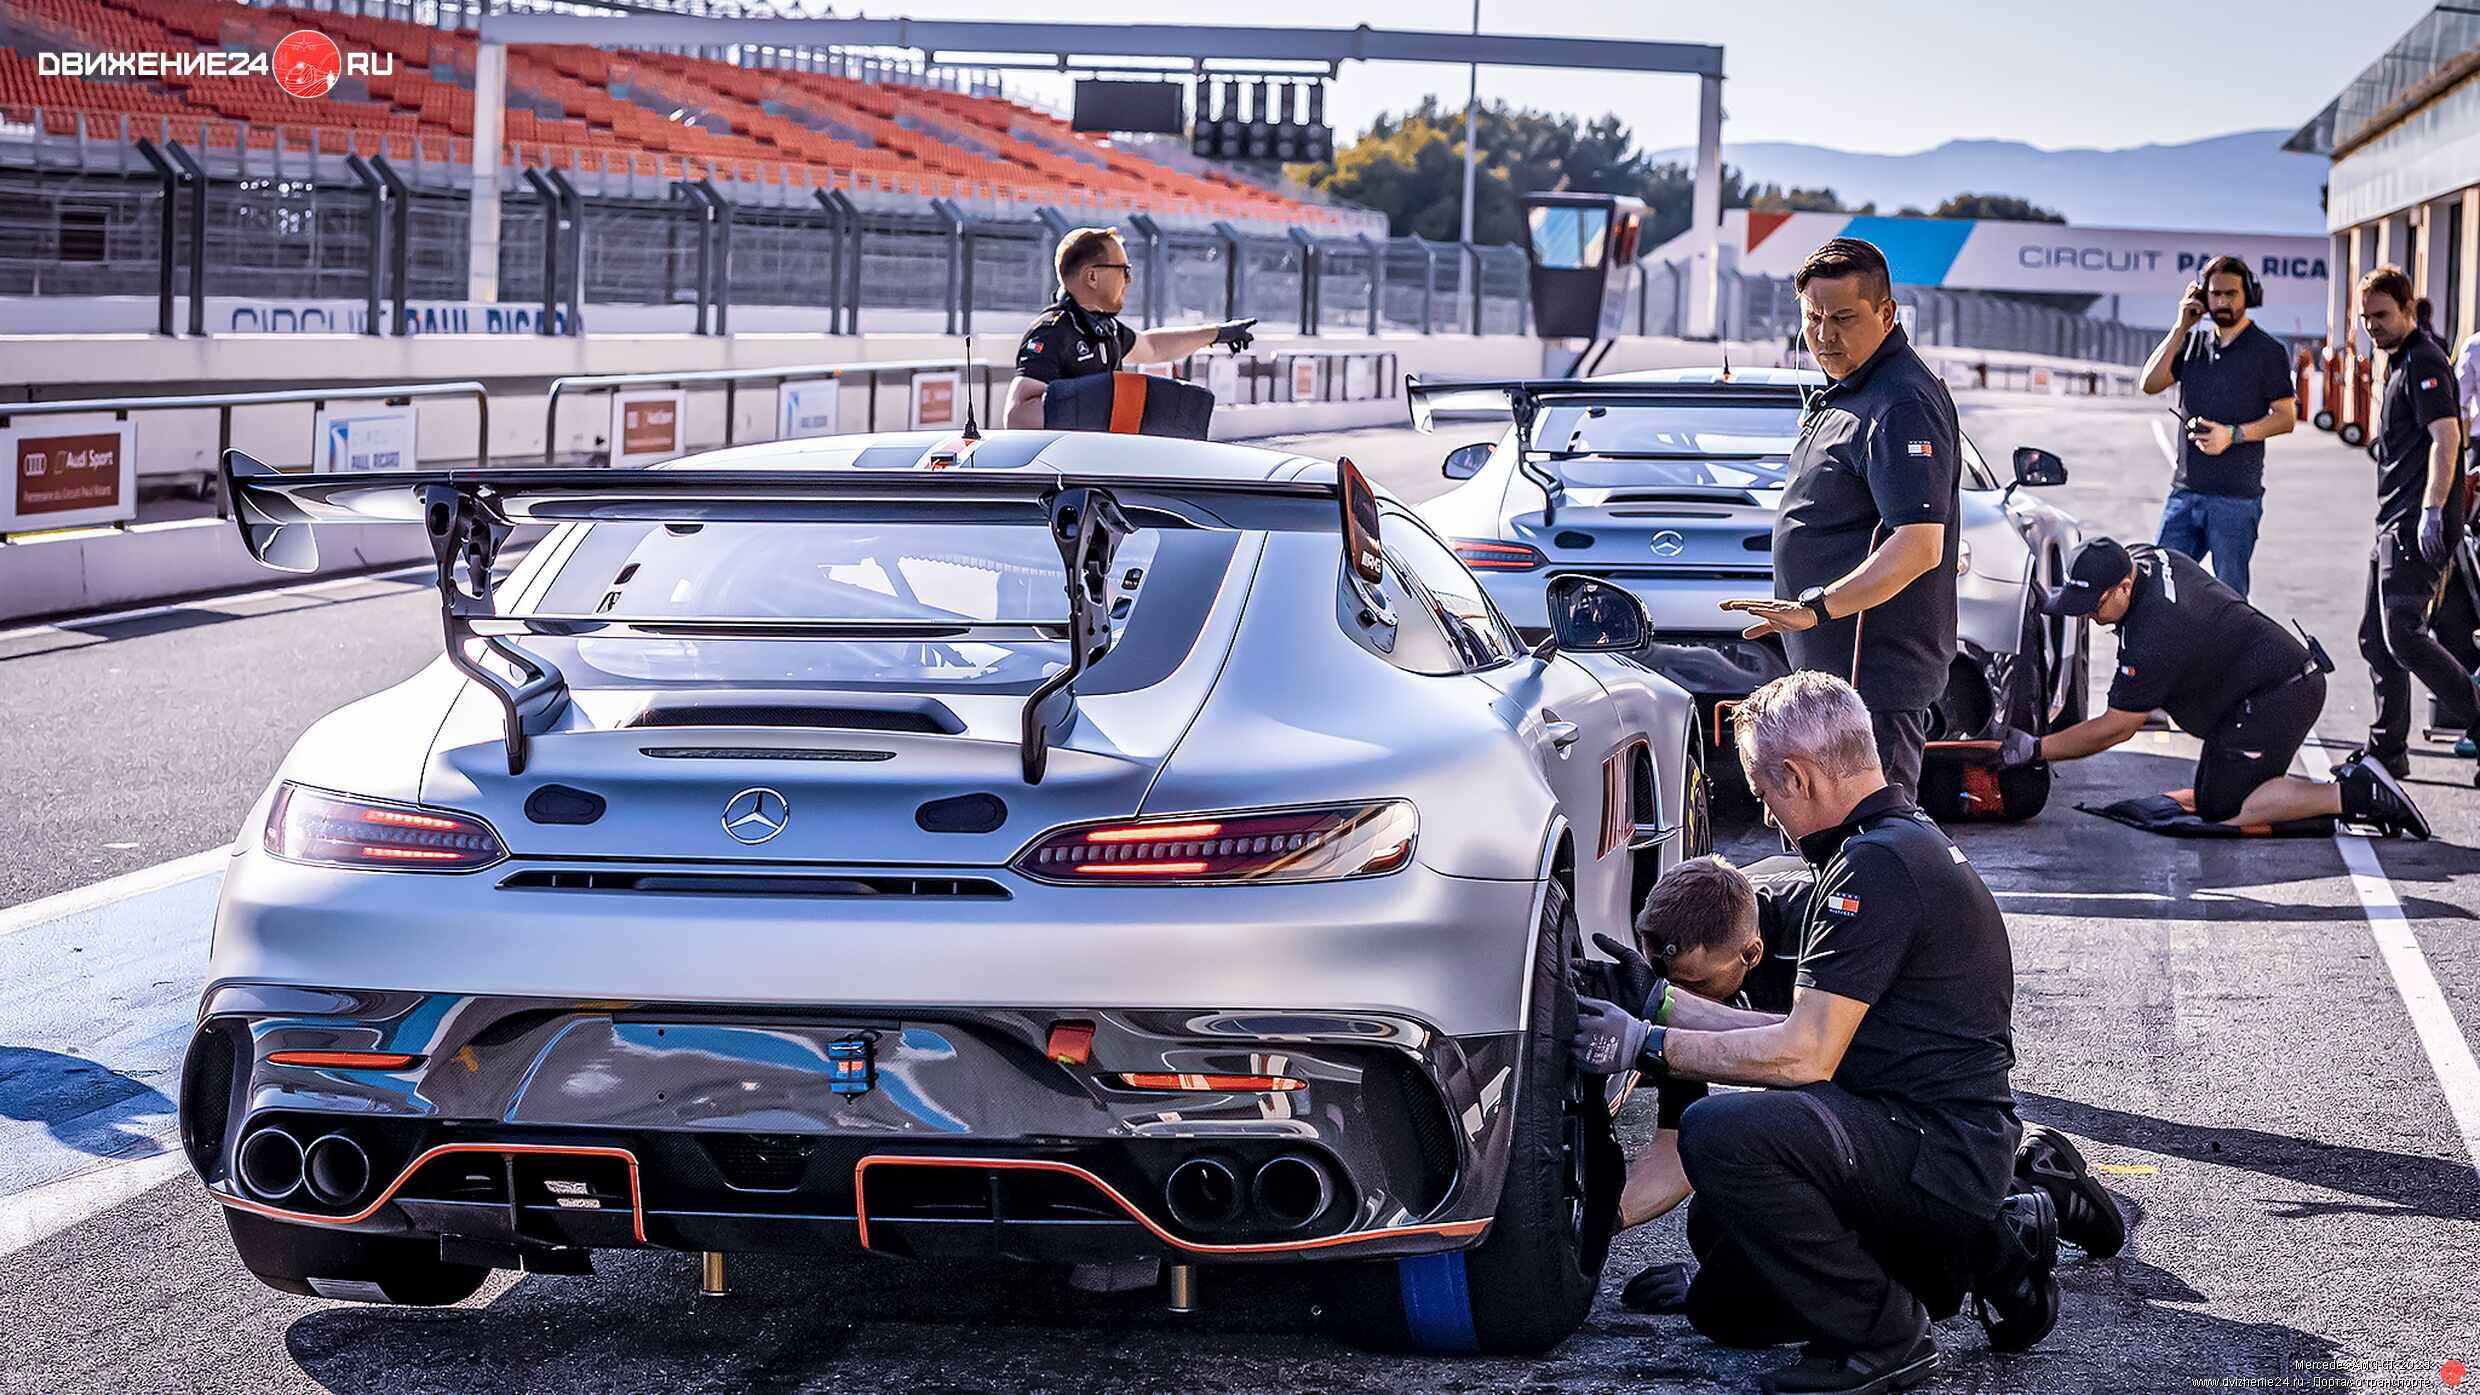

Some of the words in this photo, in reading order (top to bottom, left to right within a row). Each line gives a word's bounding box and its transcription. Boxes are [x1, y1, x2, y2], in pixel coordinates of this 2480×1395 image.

[2018, 245, 2163, 272] CIRCUIT
[66, 449, 87, 469] Audi
[88, 448, 113, 470] Sport
